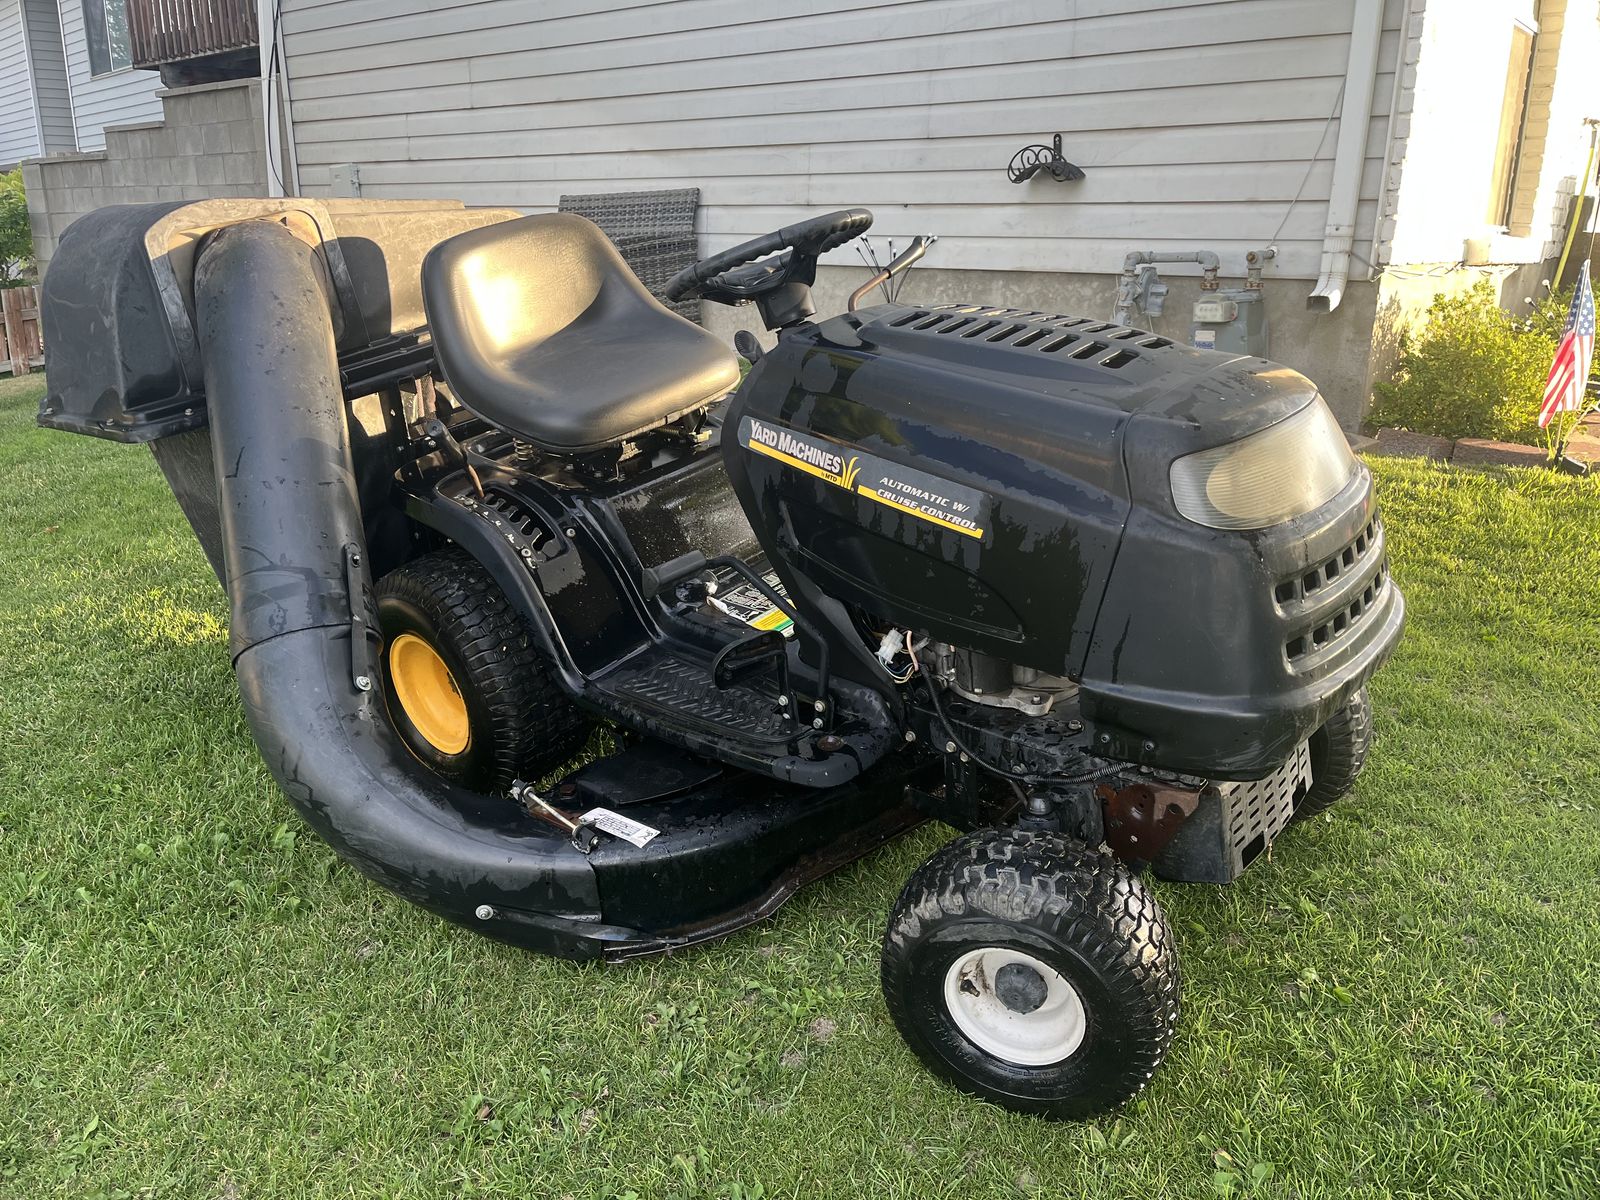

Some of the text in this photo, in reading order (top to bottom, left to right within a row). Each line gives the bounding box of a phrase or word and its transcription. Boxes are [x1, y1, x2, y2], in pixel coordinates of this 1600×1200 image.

[750, 419, 841, 473] YARD MACHINES
[825, 473, 838, 482] MTD
[880, 477, 970, 512] AUTOMATIC W/
[877, 489, 977, 530] CRUISE CONTROL
